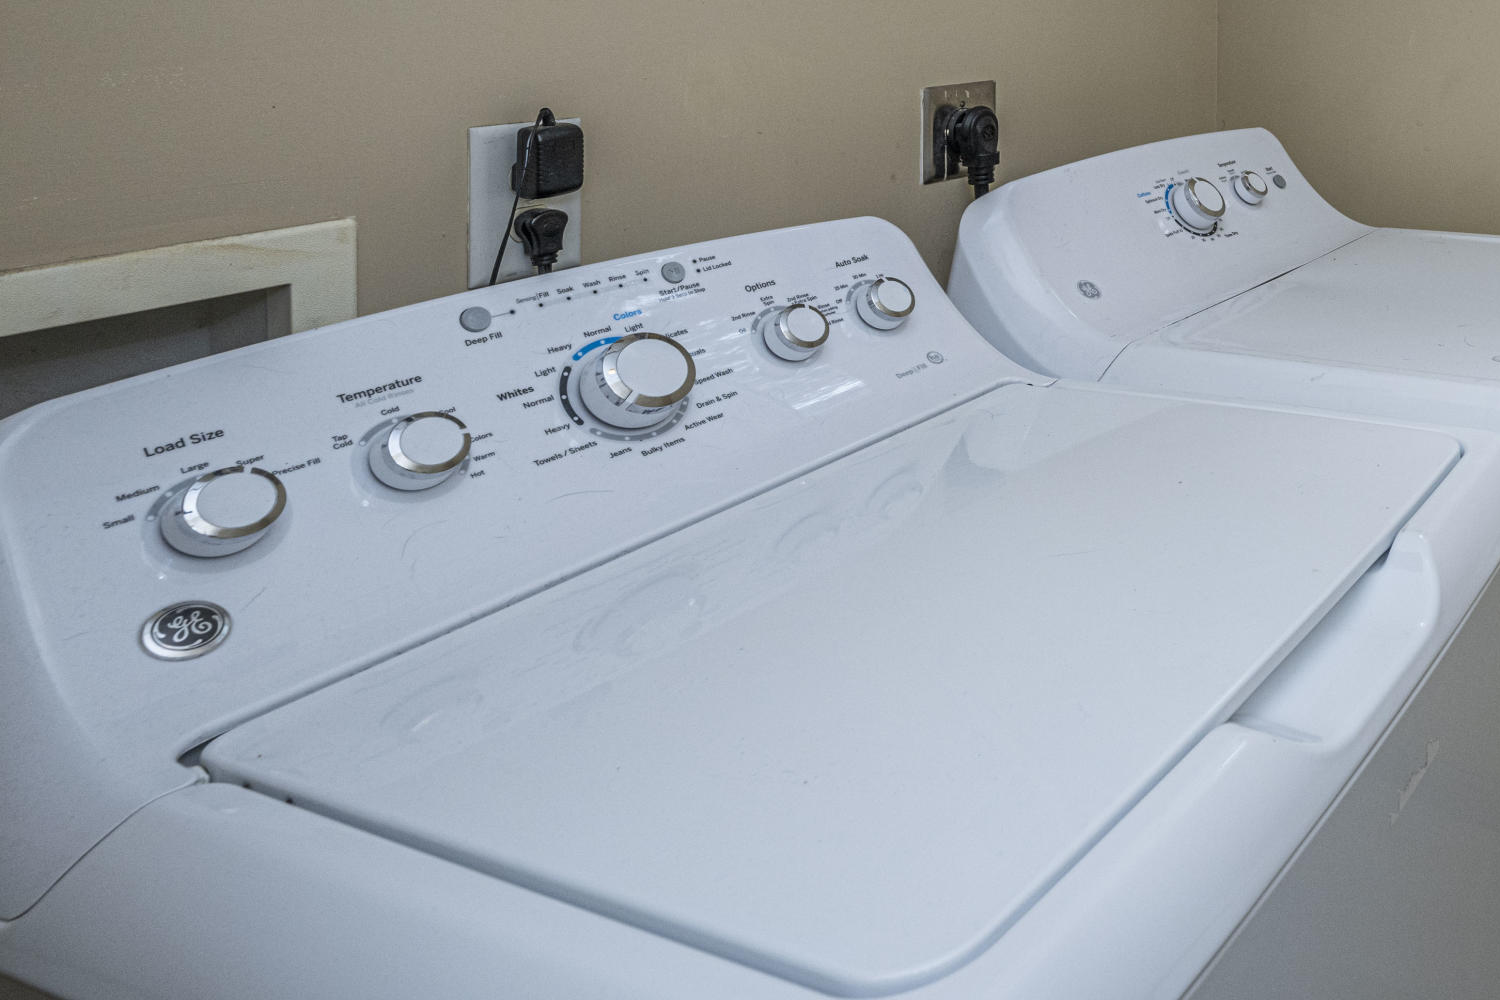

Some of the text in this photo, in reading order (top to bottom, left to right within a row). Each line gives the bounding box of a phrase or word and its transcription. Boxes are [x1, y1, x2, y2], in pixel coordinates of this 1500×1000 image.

[698, 255, 716, 263] Pause
[712, 260, 732, 271] Locked
[835, 254, 869, 268] Auto Soak
[608, 273, 626, 283] Rinse
[635, 268, 650, 277] Spin
[556, 285, 574, 295] Soak
[582, 280, 601, 289] Wash
[658, 282, 700, 296] Start/Pause
[744, 280, 776, 293] Options
[613, 309, 643, 322] Colors
[583, 325, 612, 338] Normal
[624, 323, 644, 334] Light
[464, 331, 503, 348] Deep Fill
[547, 343, 573, 354] Heavy
[534, 366, 557, 378] Light
[715, 368, 734, 379] Wash
[336, 375, 423, 404] Temperature
[496, 386, 535, 402] Whites
[522, 395, 555, 409] Normal
[696, 399, 715, 409] Drain
[721, 390, 738, 400] Spin
[380, 406, 400, 416] Cold
[684, 412, 724, 431] Active Wear
[544, 423, 571, 436] Heavy
[143, 428, 225, 458] Load Size
[332, 433, 348, 443] Tap
[333, 439, 354, 450] Cold
[470, 432, 494, 444] Colors
[533, 452, 563, 467] Towels
[568, 440, 598, 454] Sheets
[609, 446, 633, 459] Jeans
[641, 437, 686, 457] Bulky Items
[236, 454, 265, 467] Super
[473, 451, 496, 462] Warm
[180, 461, 210, 475] Large
[271, 457, 321, 477] Precise Fill
[470, 470, 486, 479] Hot
[115, 484, 161, 502] Medium
[103, 514, 136, 530] Small
